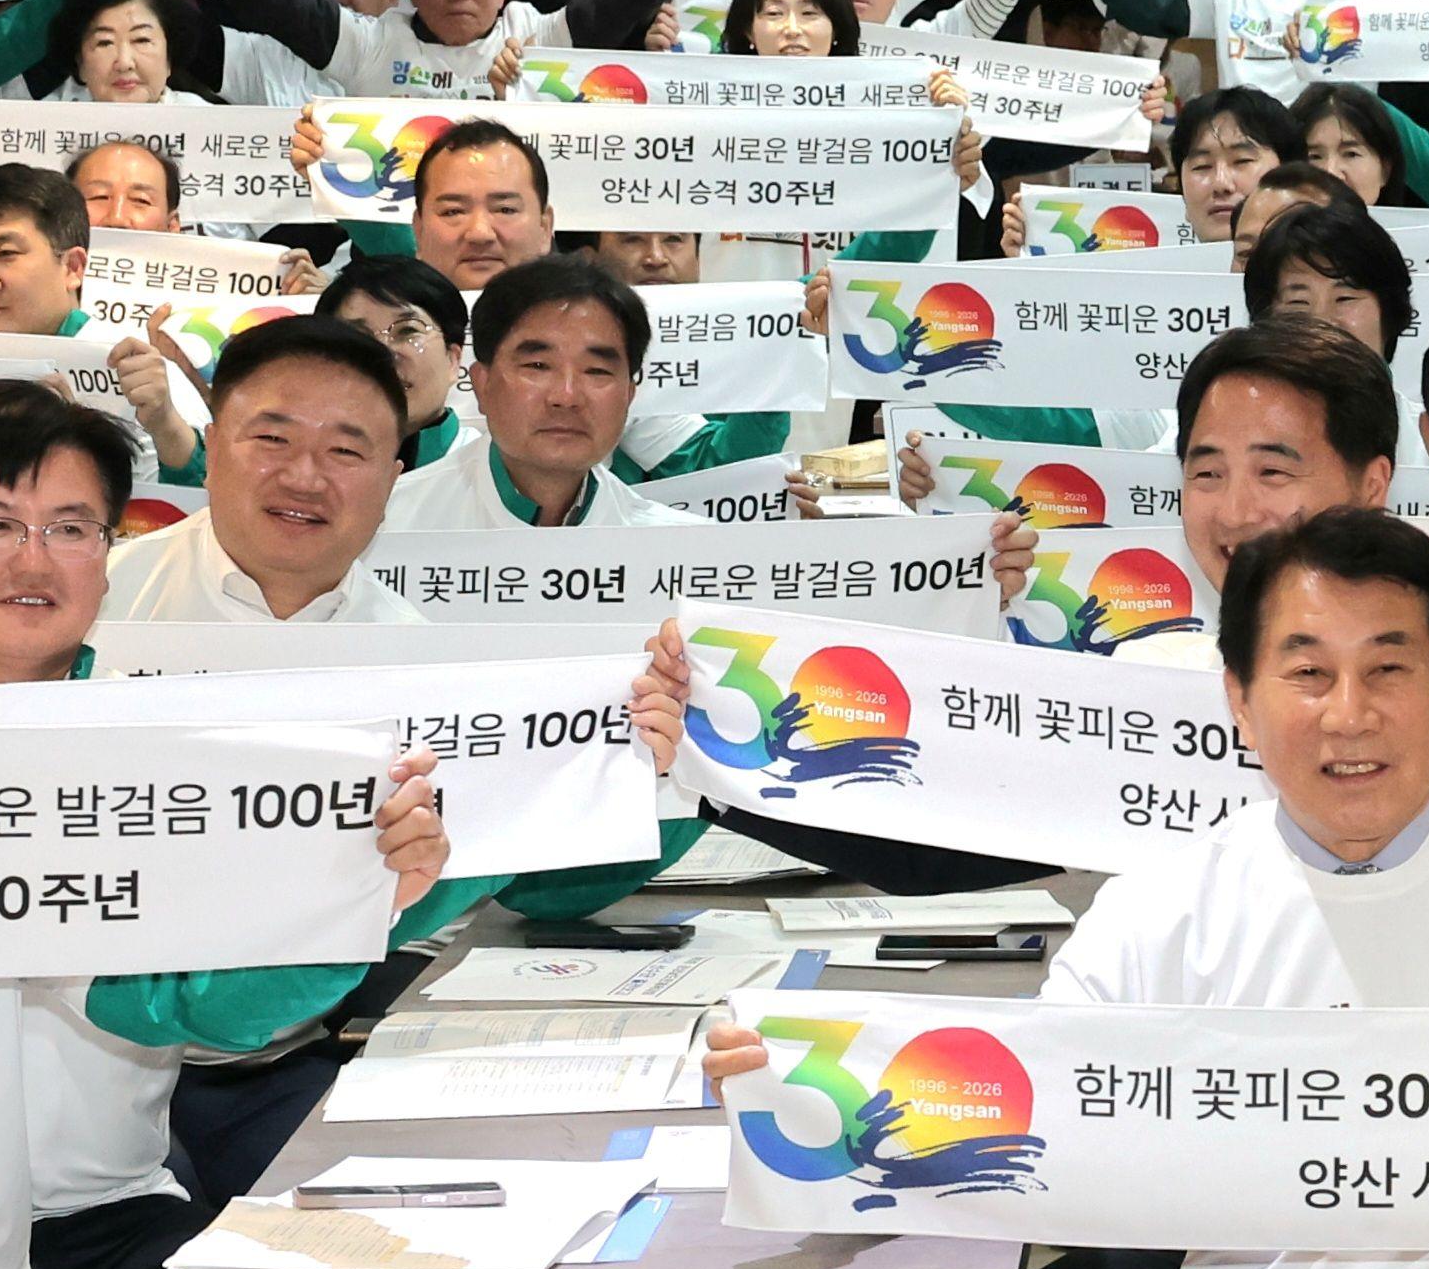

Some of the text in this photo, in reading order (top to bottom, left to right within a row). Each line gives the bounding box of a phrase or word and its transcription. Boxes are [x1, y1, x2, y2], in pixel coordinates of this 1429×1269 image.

[549, 135, 952, 164] 꽃피운 30년 새로운 발걸음 100년
[420, 552, 985, 603] 꽃피운 30년 새로운 발걸음 100년
[813, 702, 888, 725] Yangsan
[942, 685, 1158, 754] 함께 꽃피운
[58, 784, 211, 837] 발걸음
[231, 777, 376, 830] 100년
[909, 1080, 1003, 1097] 1996 2026
[1074, 1063, 1171, 1119] 함께
[1192, 1068, 1345, 1121] 꽃피운
[909, 1101, 1002, 1124] Yangsan
